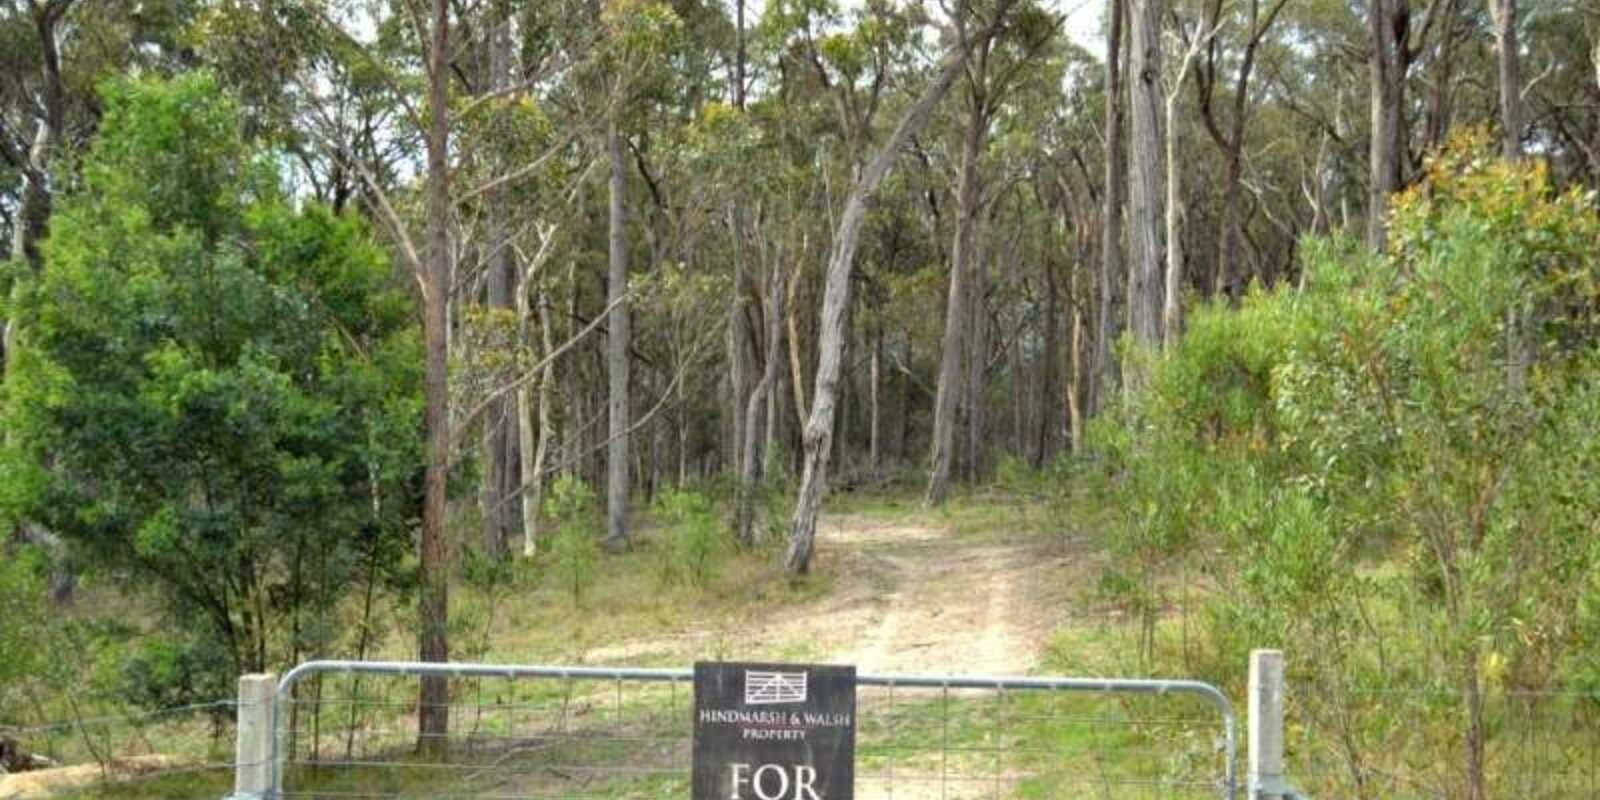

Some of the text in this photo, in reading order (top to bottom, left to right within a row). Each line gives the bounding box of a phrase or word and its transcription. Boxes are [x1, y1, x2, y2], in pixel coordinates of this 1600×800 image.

[700, 709, 851, 727] HINDMARSH & WALSH
[743, 728, 807, 741] PROPERTY
[730, 763, 823, 800] FOR
